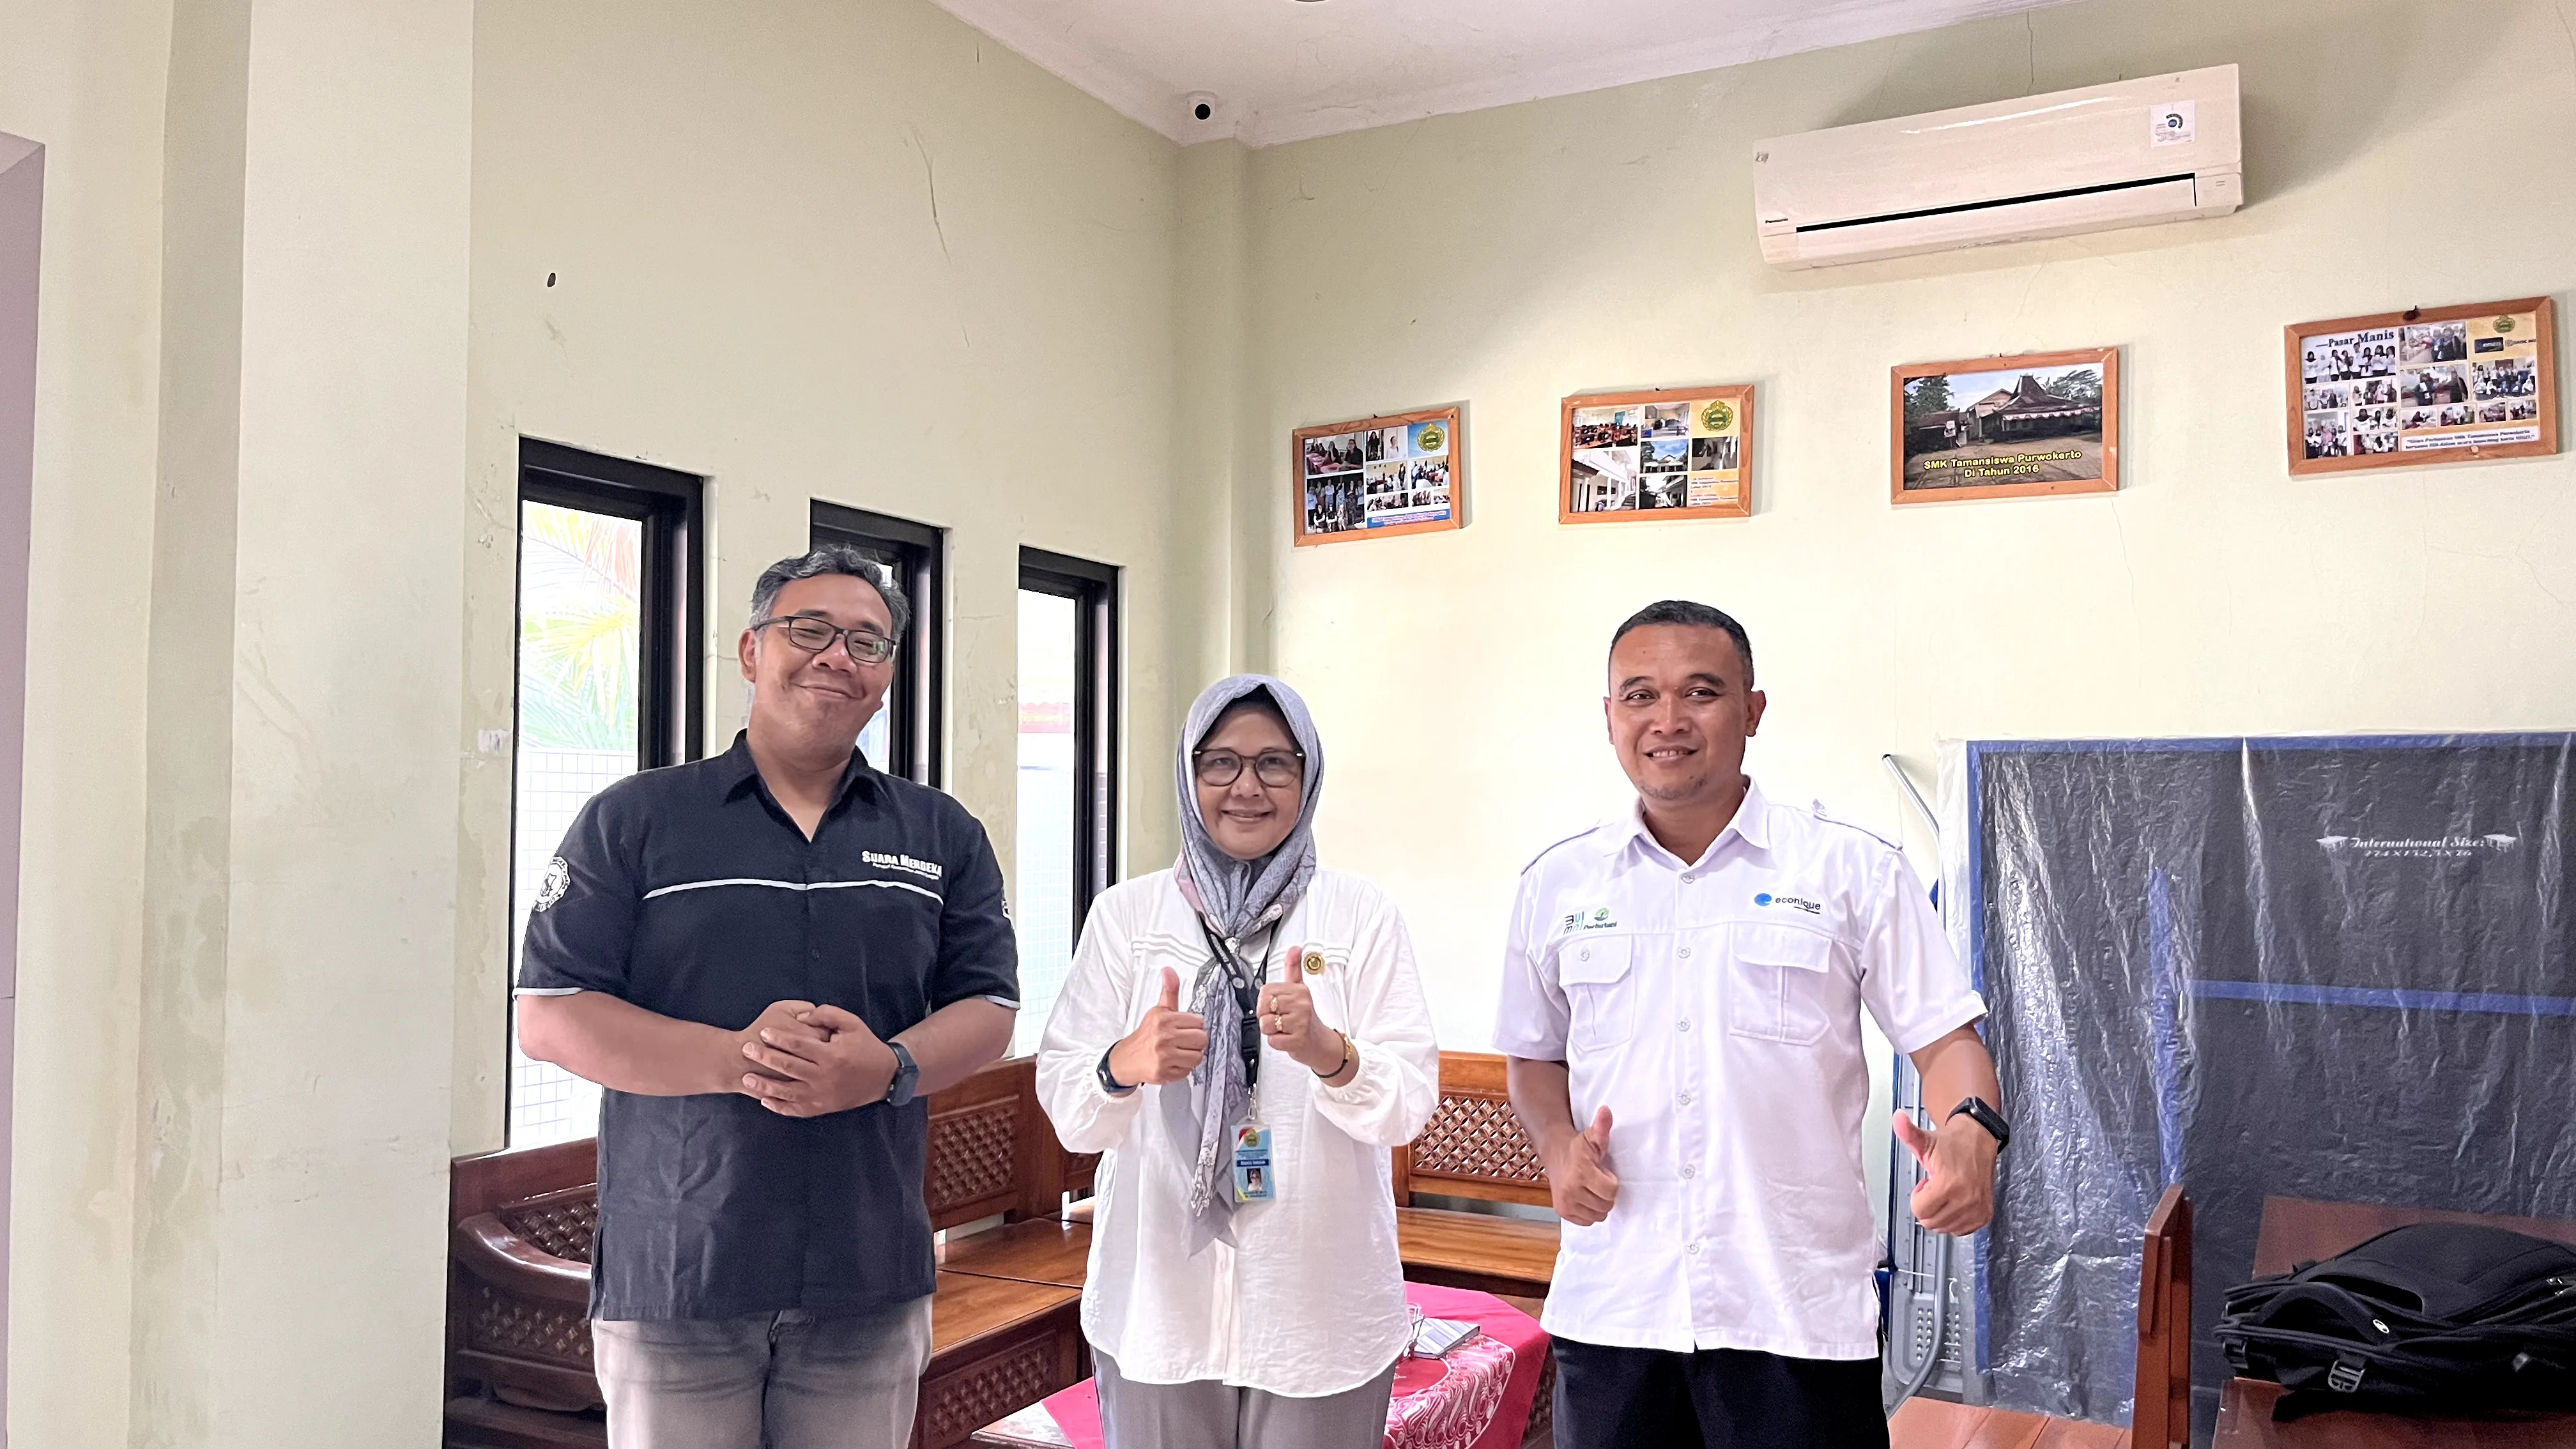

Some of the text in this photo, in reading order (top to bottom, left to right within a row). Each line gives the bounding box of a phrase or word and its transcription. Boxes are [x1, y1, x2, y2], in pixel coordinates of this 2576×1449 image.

[2328, 330, 2395, 347] Pasar Manis
[1924, 450, 2083, 470] SMK Tamansiswa Purwokerto
[1978, 467, 2011, 477] Tahun
[2013, 464, 2039, 474] 2016
[2350, 836, 2484, 848] International Size:
[862, 850, 899, 865] SUARA
